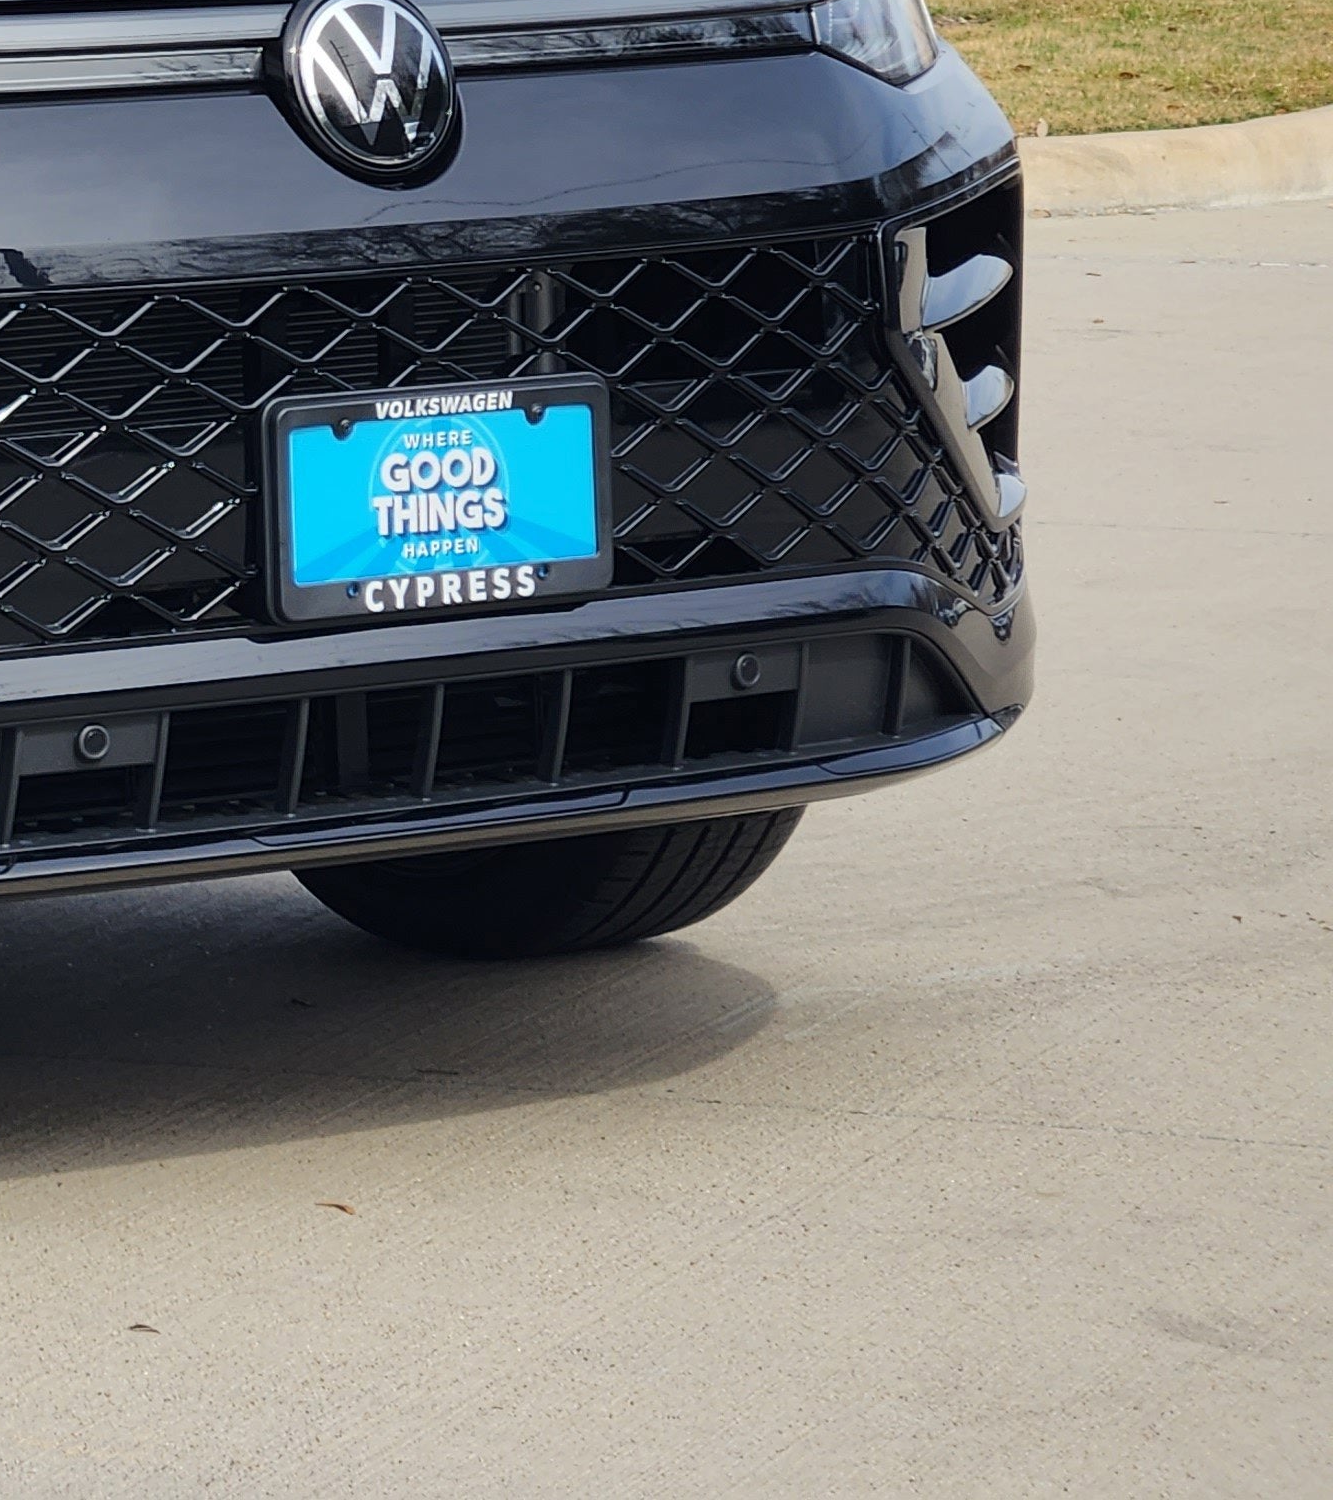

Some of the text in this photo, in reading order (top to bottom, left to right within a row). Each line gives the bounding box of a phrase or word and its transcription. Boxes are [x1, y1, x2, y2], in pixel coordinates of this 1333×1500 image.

[375, 391, 513, 419] VOLKSWAGEN
[404, 429, 473, 449] WHERE
[381, 447, 495, 492] GOOD
[373, 489, 506, 536] THINGS
[403, 539, 479, 559] HAPPEN
[364, 565, 535, 614] CYPRESS
